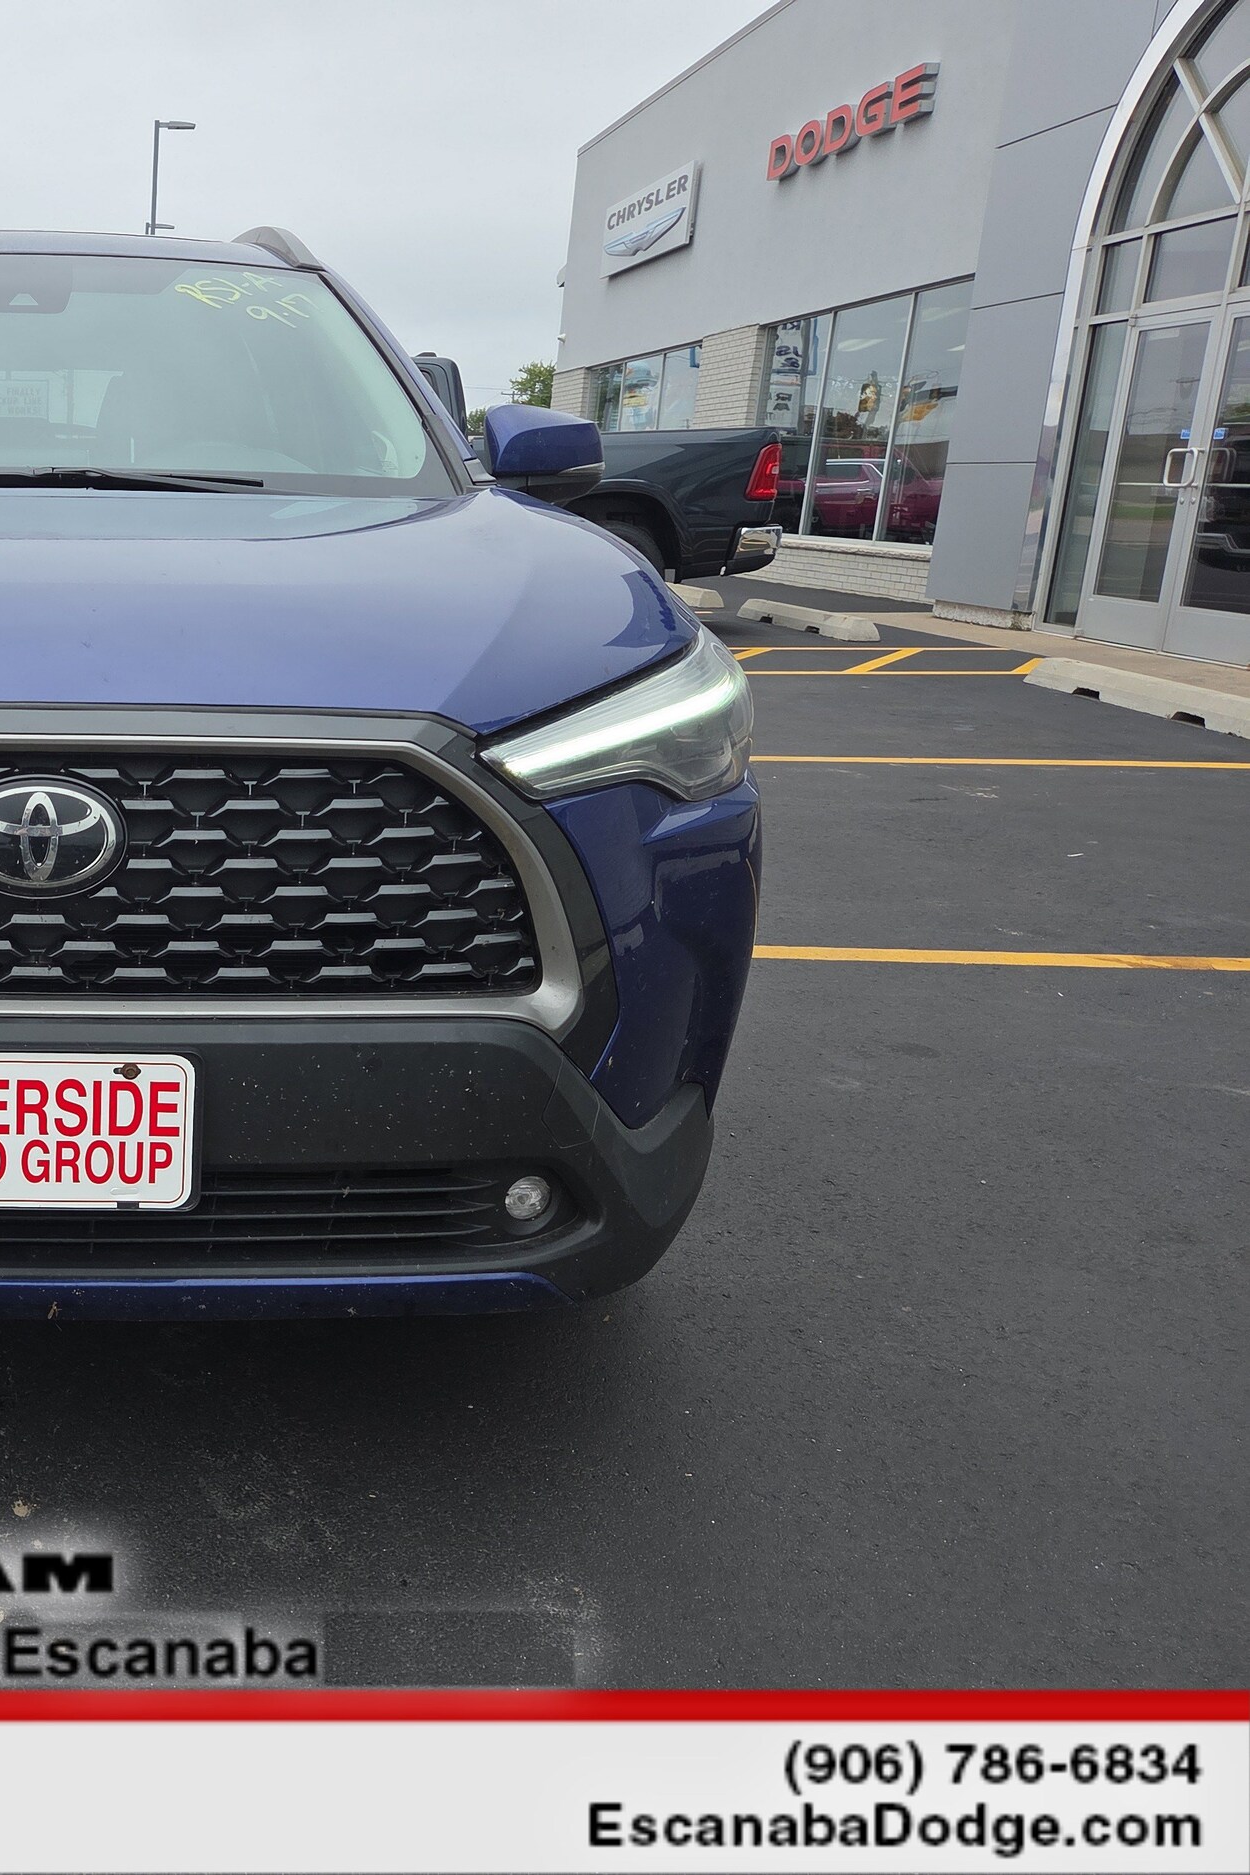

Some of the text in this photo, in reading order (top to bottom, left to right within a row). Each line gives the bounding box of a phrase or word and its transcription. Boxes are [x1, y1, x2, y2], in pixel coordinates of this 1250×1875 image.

[766, 62, 940, 181] DODGE
[607, 174, 689, 231] CHRYSLER
[6, 387, 40, 396] FINALLY
[21, 1140, 173, 1184] GROUP
